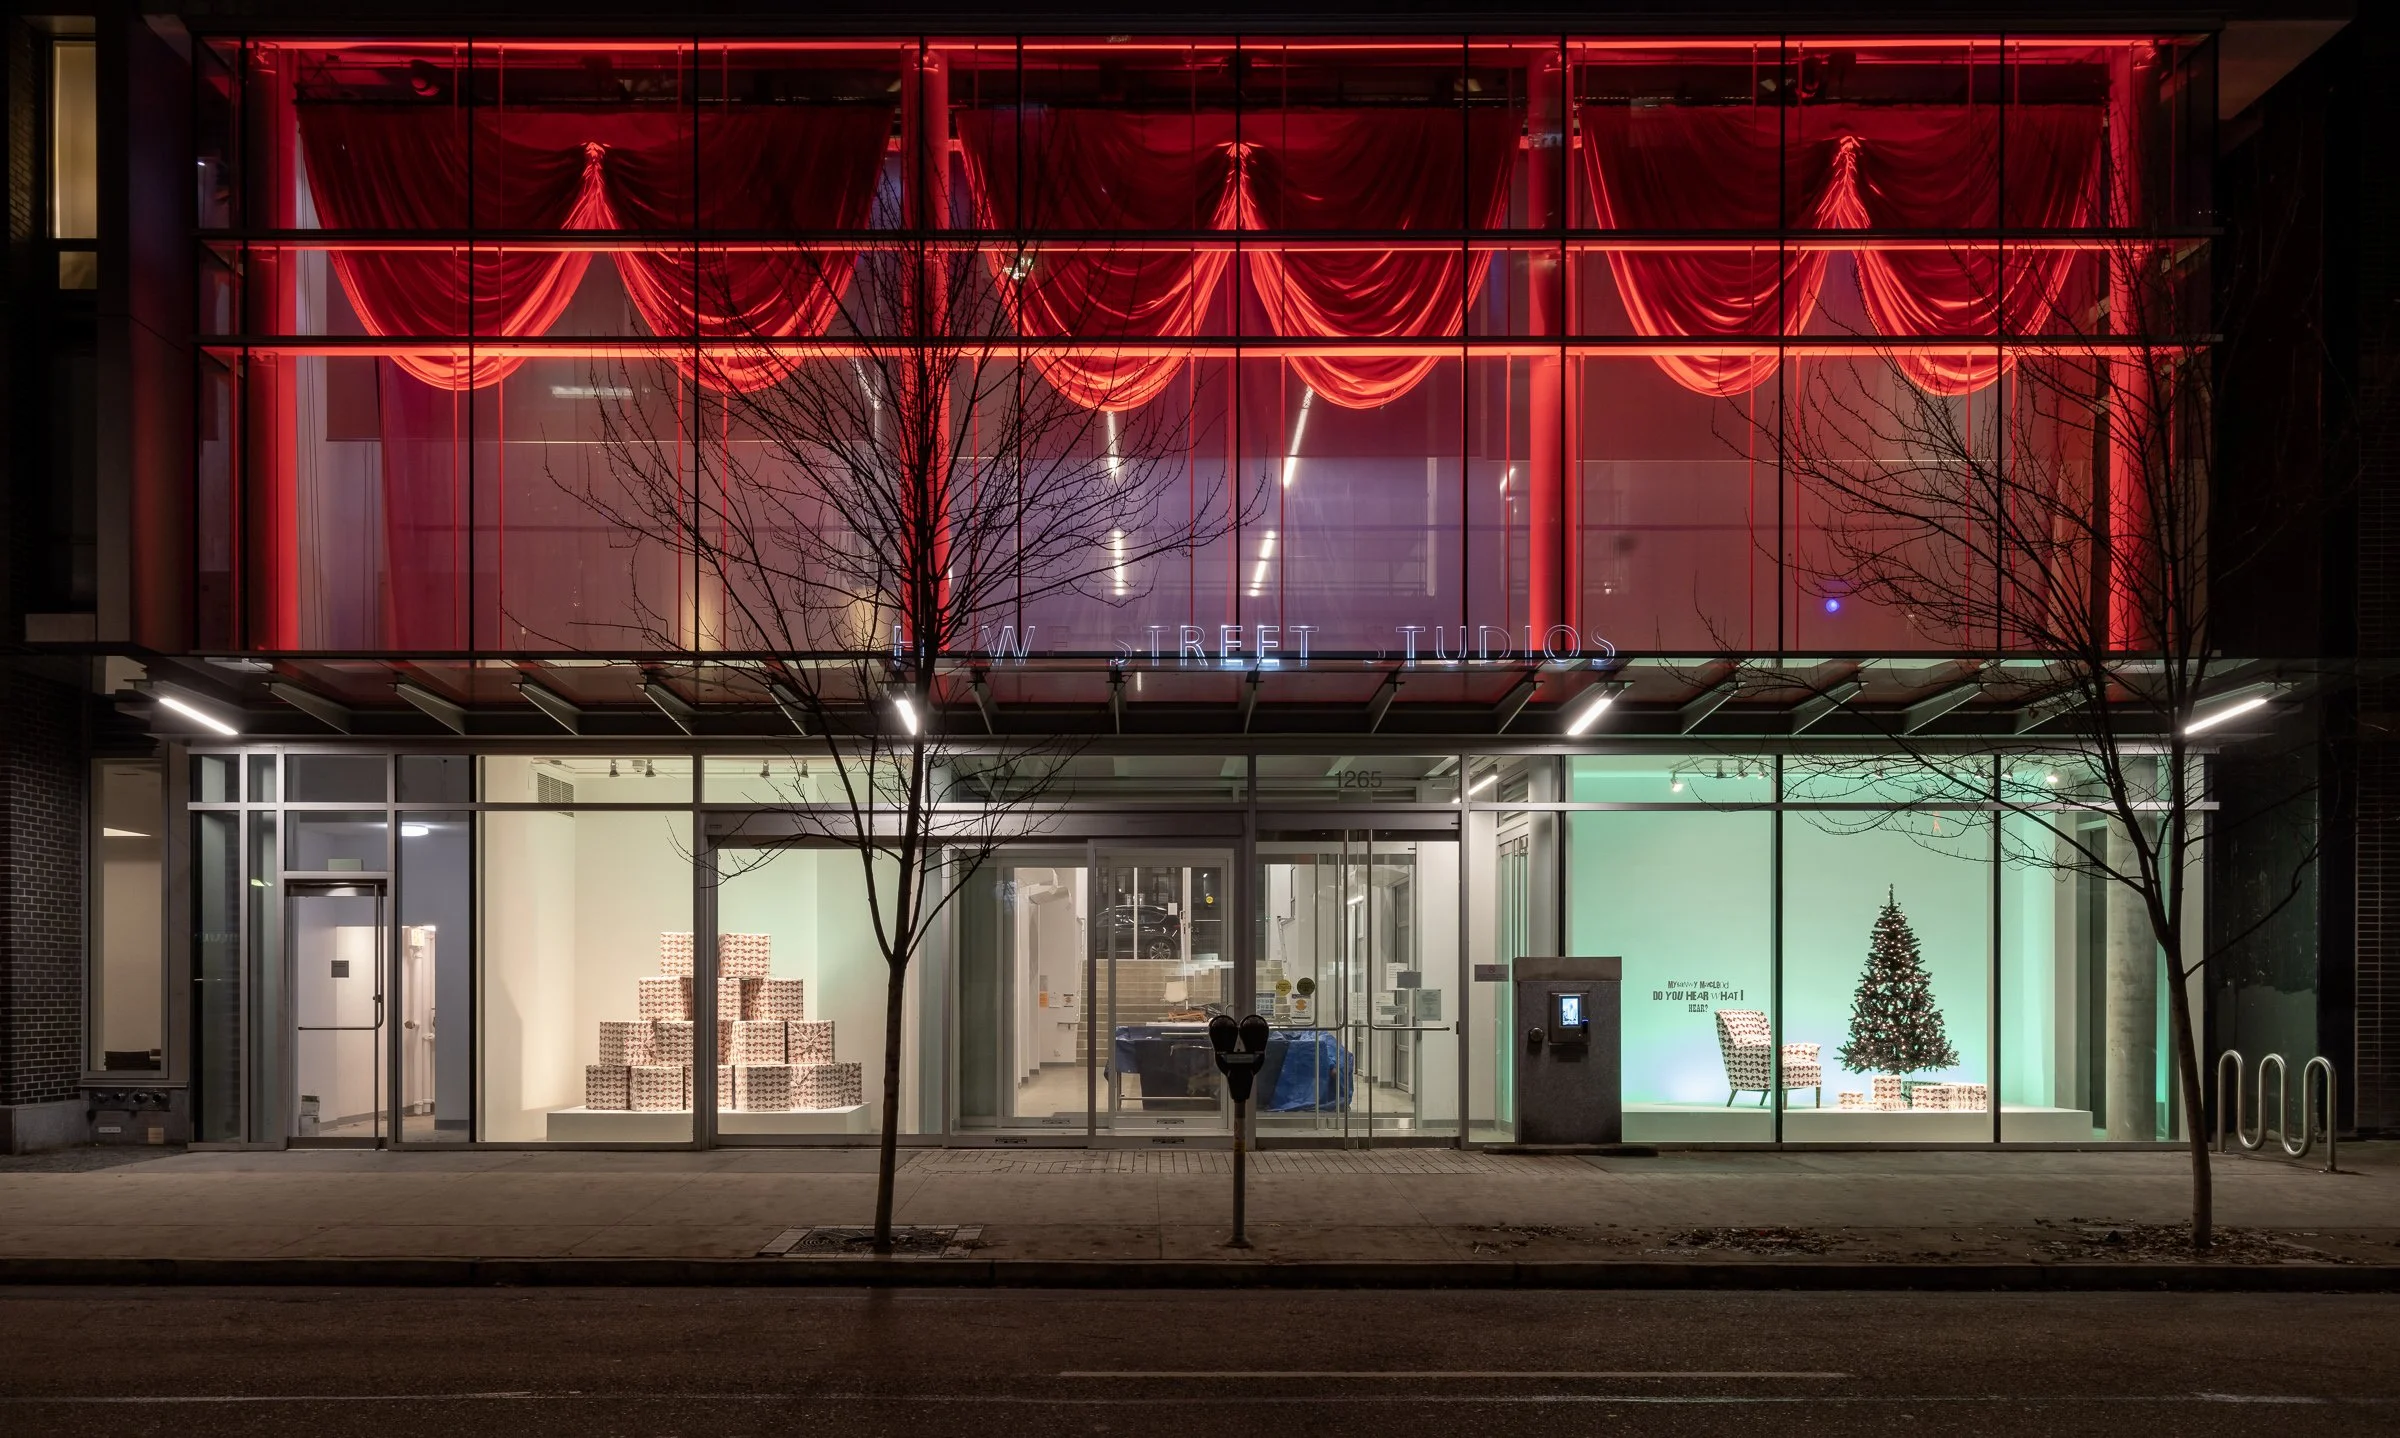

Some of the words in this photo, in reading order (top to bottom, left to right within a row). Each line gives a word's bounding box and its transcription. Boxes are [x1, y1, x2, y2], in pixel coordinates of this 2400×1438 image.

[1334, 770, 1382, 788] 1265
[1652, 991, 1663, 1001] DO
[1665, 991, 1684, 1001] YOU
[1686, 991, 1709, 1001] HEAR
[1740, 989, 1744, 1001] I
[1688, 1004, 1709, 1013] HEAR?
